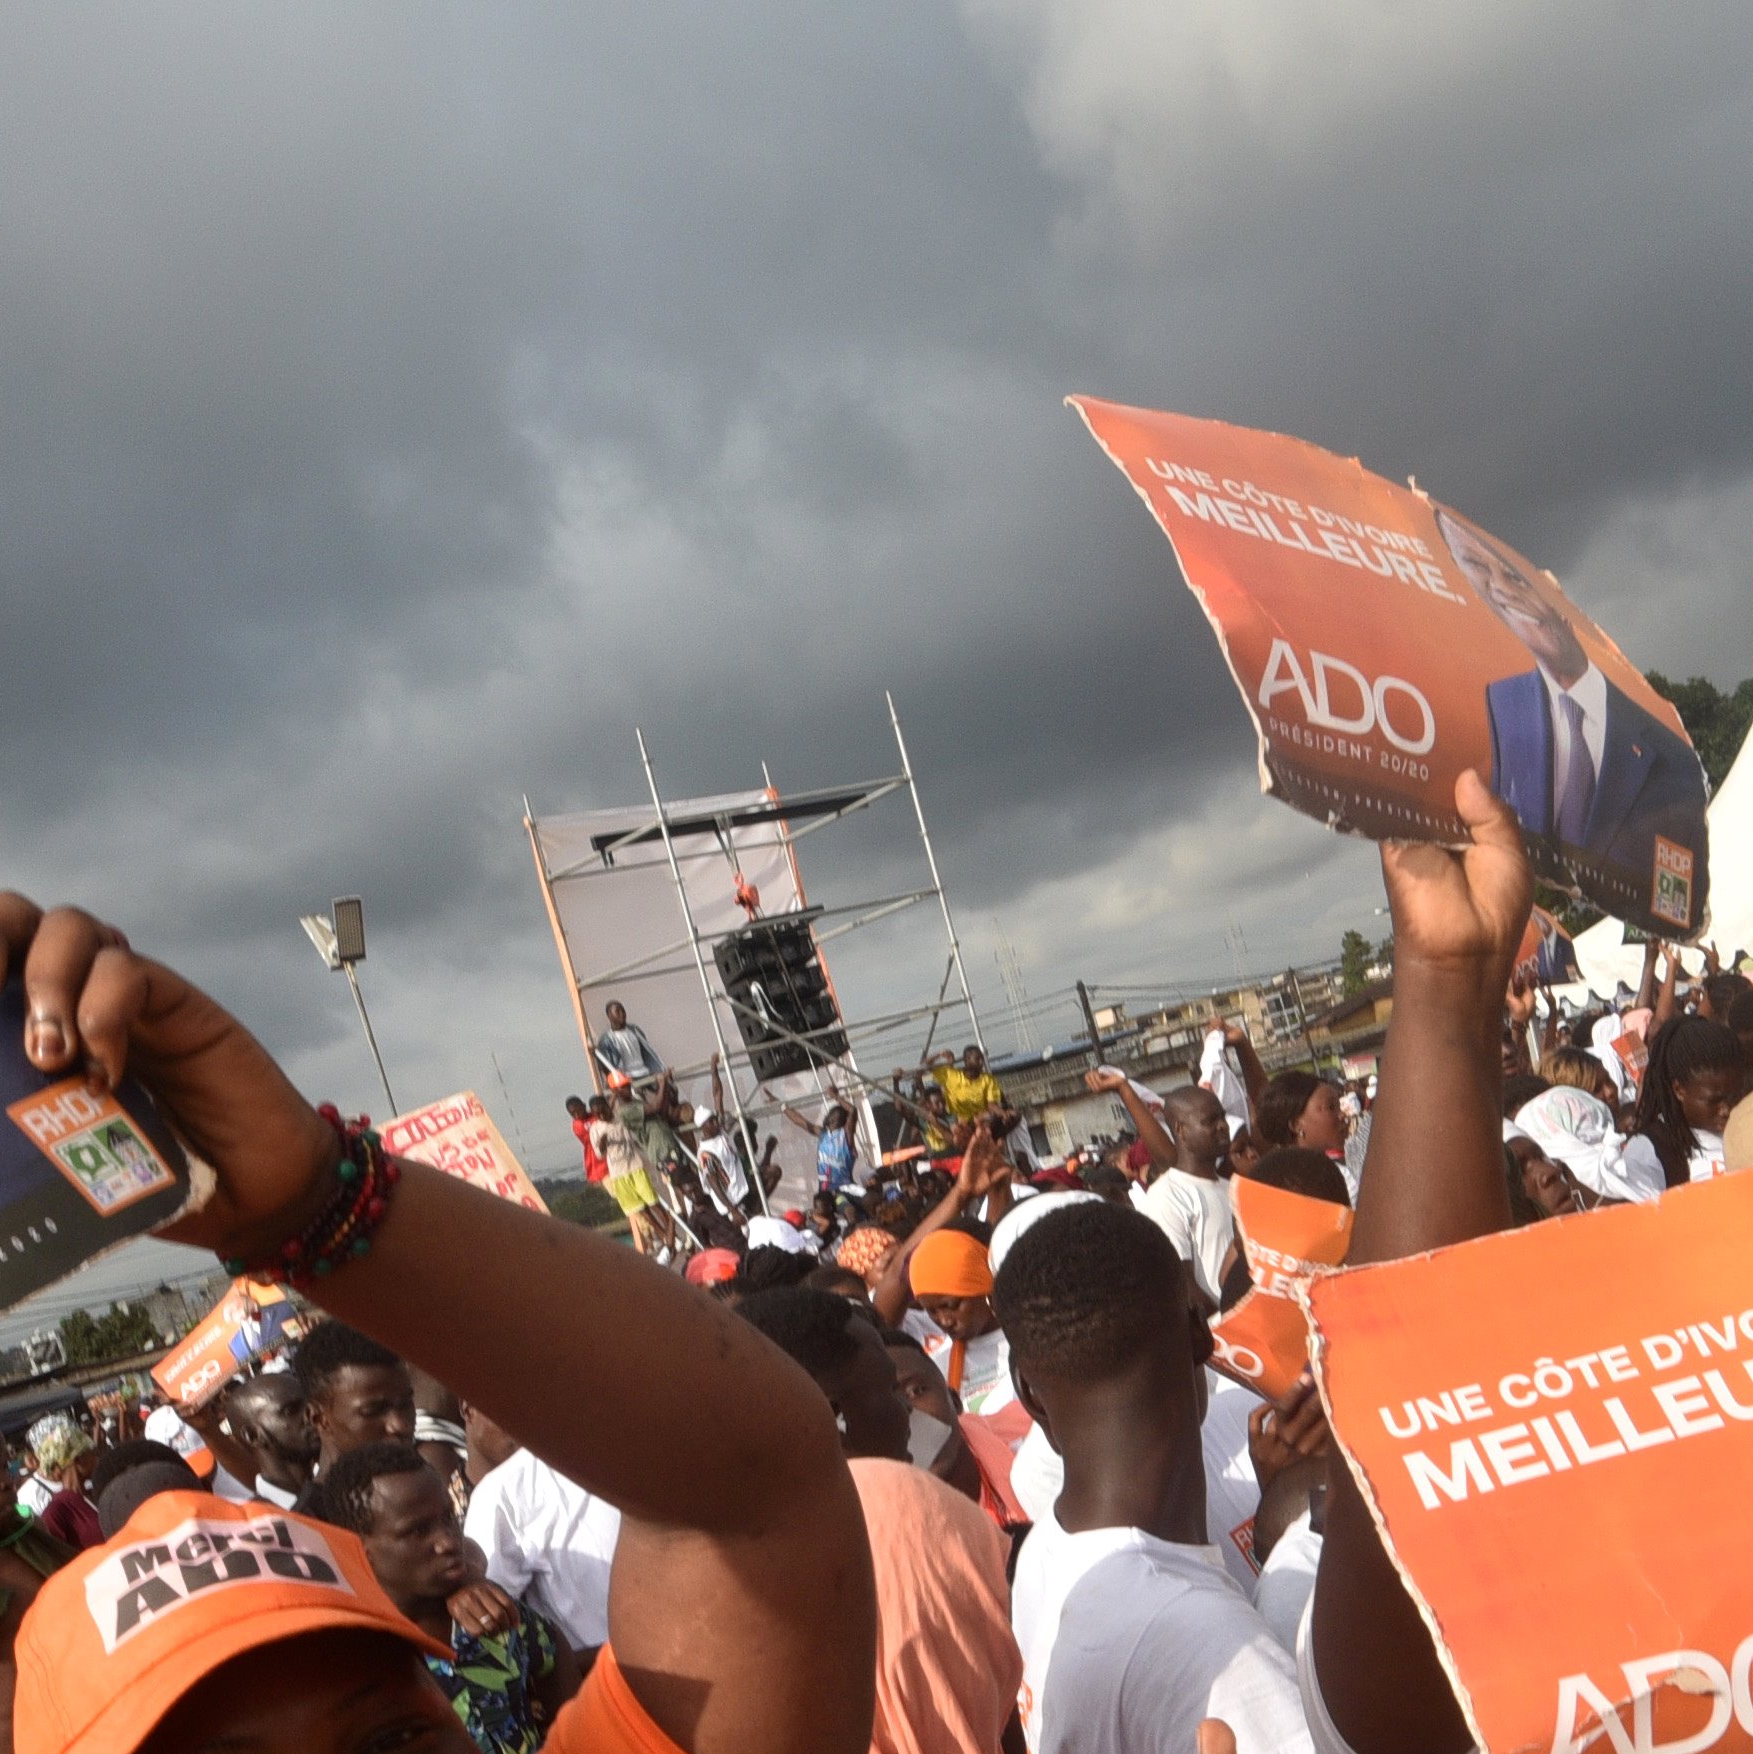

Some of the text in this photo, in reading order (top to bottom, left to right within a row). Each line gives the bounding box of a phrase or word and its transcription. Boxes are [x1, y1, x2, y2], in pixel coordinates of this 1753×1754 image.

[1145, 457, 1433, 561] UNE CÔTE D'IVOIRE
[1165, 485, 1467, 606] MEILLEURE.
[1258, 637, 1436, 755] ADO
[1269, 717, 1429, 782] PRÉSIDENT 20/20
[1657, 843, 1693, 873] RHDP
[1378, 1383, 1494, 1439] UNE
[1498, 1345, 1641, 1409] CÔTE
[115, 1550, 339, 1641] ADO
